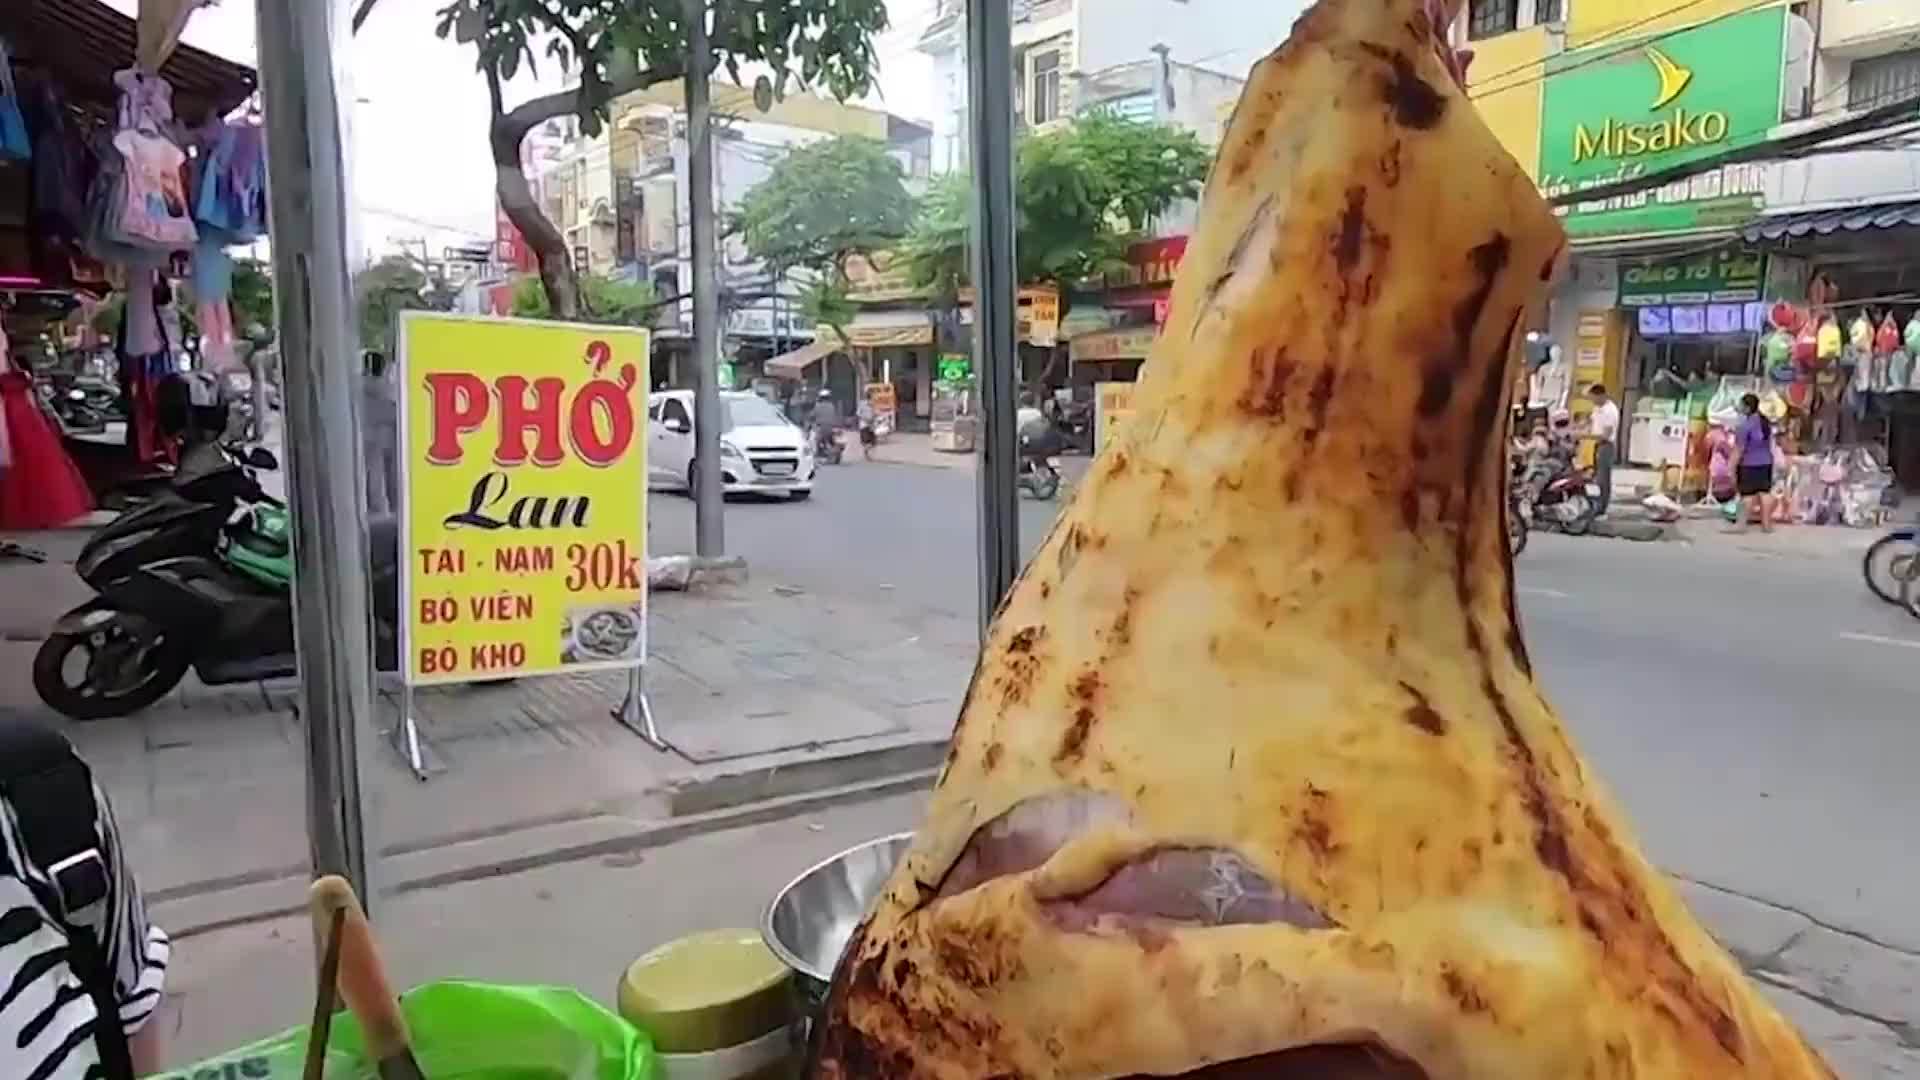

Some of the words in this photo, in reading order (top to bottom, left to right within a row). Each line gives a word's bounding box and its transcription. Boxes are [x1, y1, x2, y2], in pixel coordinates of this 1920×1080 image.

[1573, 108, 1728, 164] Misako
[423, 340, 637, 467] PHỞ
[443, 471, 590, 530] Lan
[565, 539, 641, 592] 30k
[471, 642, 526, 670] KHO
